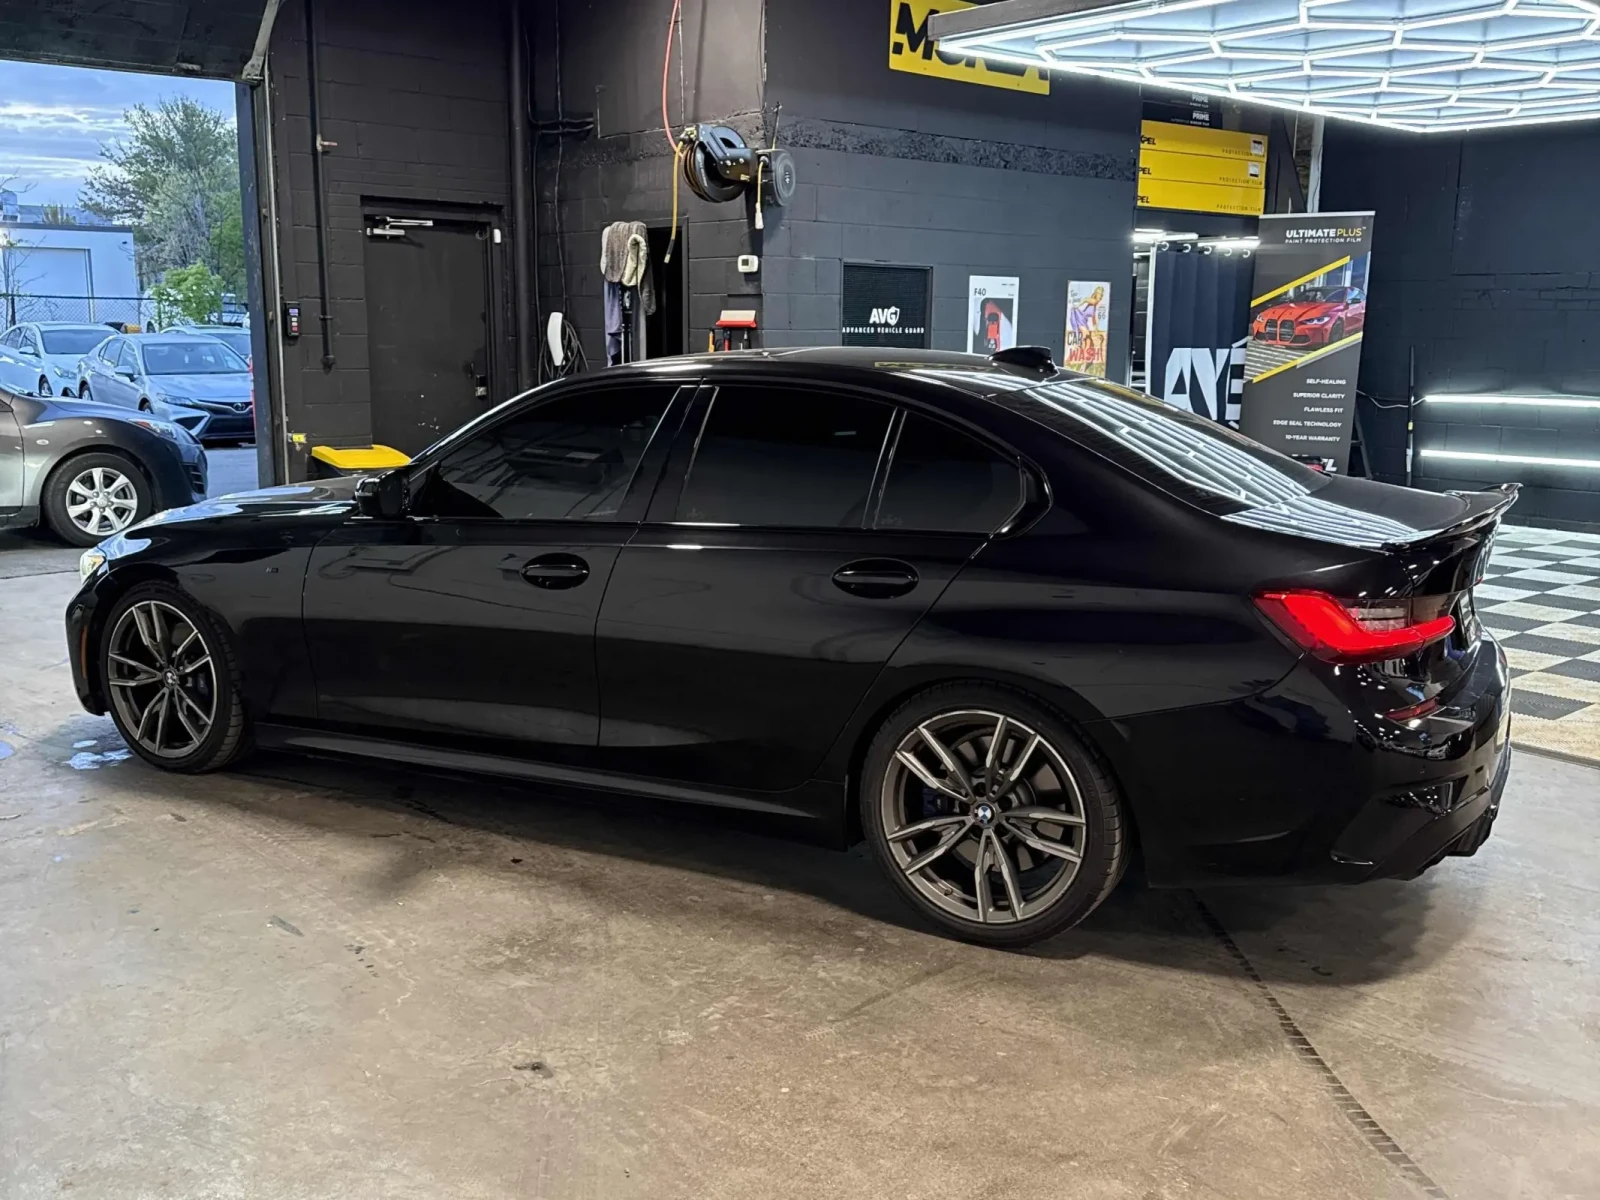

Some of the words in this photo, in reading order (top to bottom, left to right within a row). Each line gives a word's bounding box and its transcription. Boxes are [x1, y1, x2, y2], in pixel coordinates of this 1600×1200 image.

[1192, 112, 1210, 121] PRIME
[1222, 148, 1253, 157] PROTECTION
[1219, 176, 1250, 185] PROTECTION
[974, 287, 987, 296] F40
[869, 306, 900, 326] AVG
[1067, 332, 1083, 347] CAR
